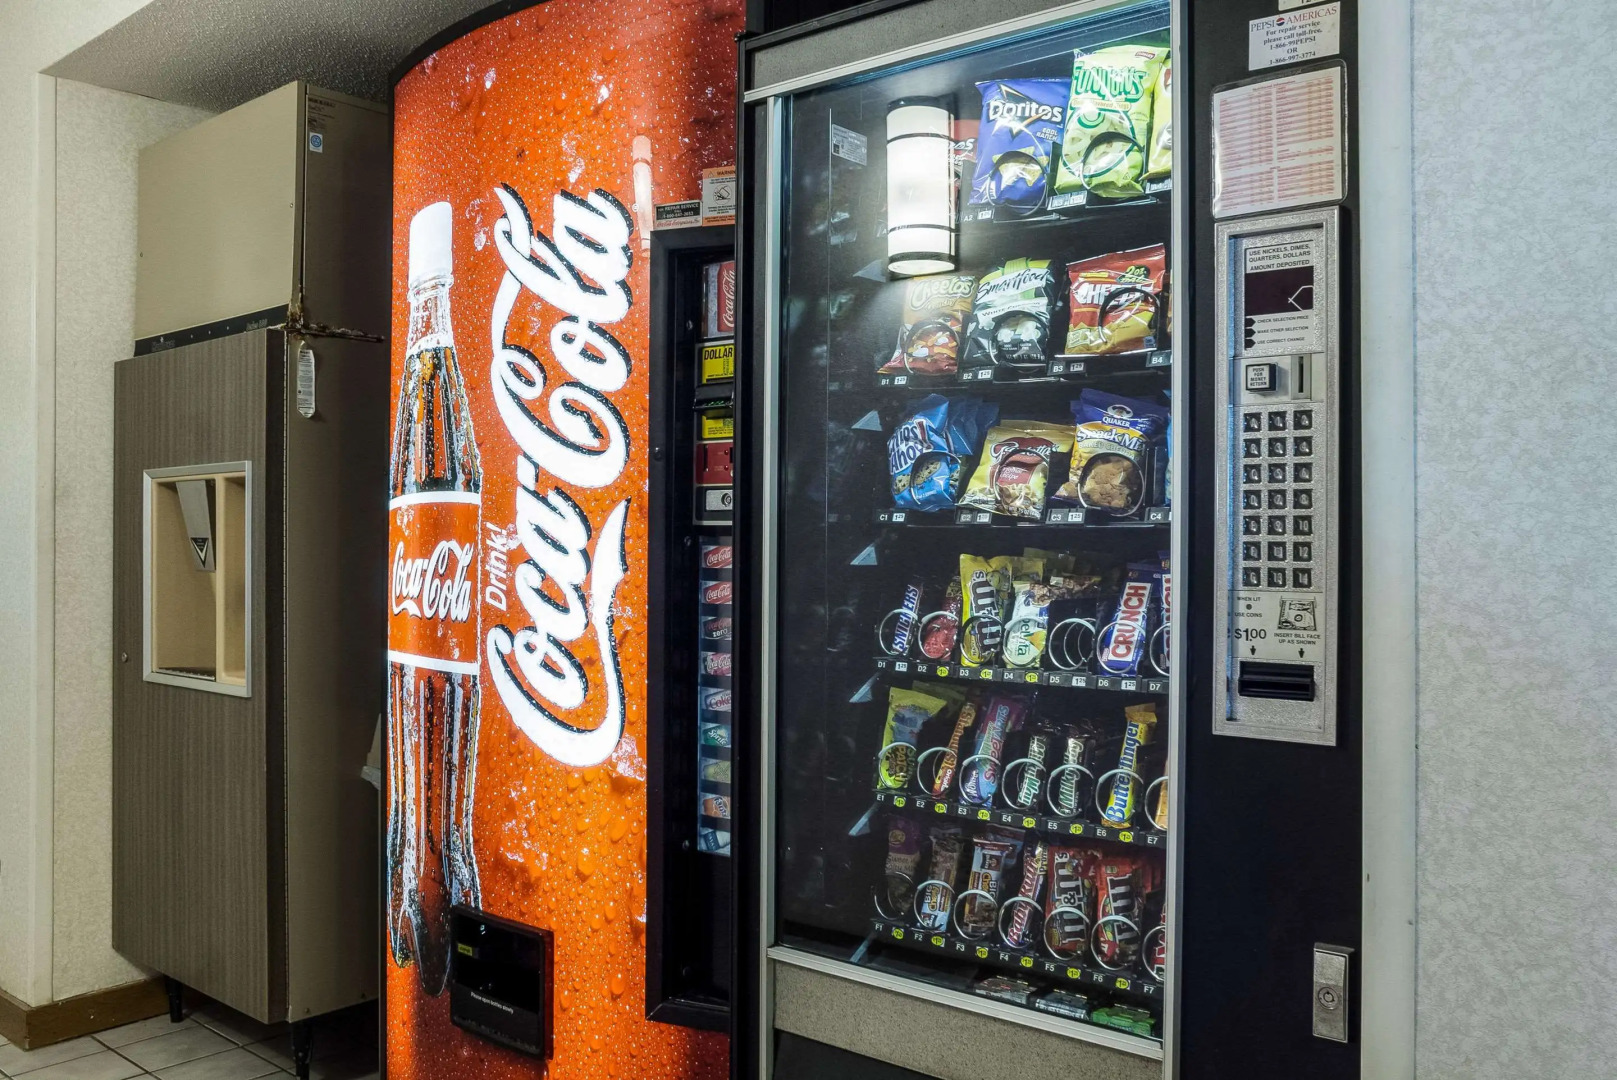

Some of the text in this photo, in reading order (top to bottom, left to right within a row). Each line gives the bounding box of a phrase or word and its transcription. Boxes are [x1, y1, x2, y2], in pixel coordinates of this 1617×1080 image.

[1251, 6, 1337, 32] PEPSI AMERICAS
[1278, 25, 1297, 34] repair
[1298, 20, 1320, 29] service
[1264, 32, 1294, 46] please call
[989, 100, 1062, 122] Doritos
[1283, 250, 1310, 258] DOLLARS
[1276, 260, 1310, 268] DEPOSITED
[976, 269, 1050, 302] Smartfood
[911, 277, 973, 310] Cheetos
[704, 348, 732, 360] DOLLAR
[1102, 416, 1131, 427] QUAKER
[1076, 428, 1144, 452] Snack Mi
[487, 182, 635, 768] Coca-Cola
[485, 522, 507, 611] Drink!
[392, 540, 474, 623] Coca-Cola
[892, 584, 919, 652] SNICKERS
[1111, 585, 1147, 659] CRUNCH
[712, 628, 728, 638] zero
[1234, 628, 1267, 642] $1.00
[708, 729, 728, 746] Sprite
[914, 933, 922, 941] F2
[1000, 953, 1008, 961] F4
[1045, 964, 1054, 972] F5
[1093, 974, 1103, 982] F6
[1144, 986, 1154, 994] F7
